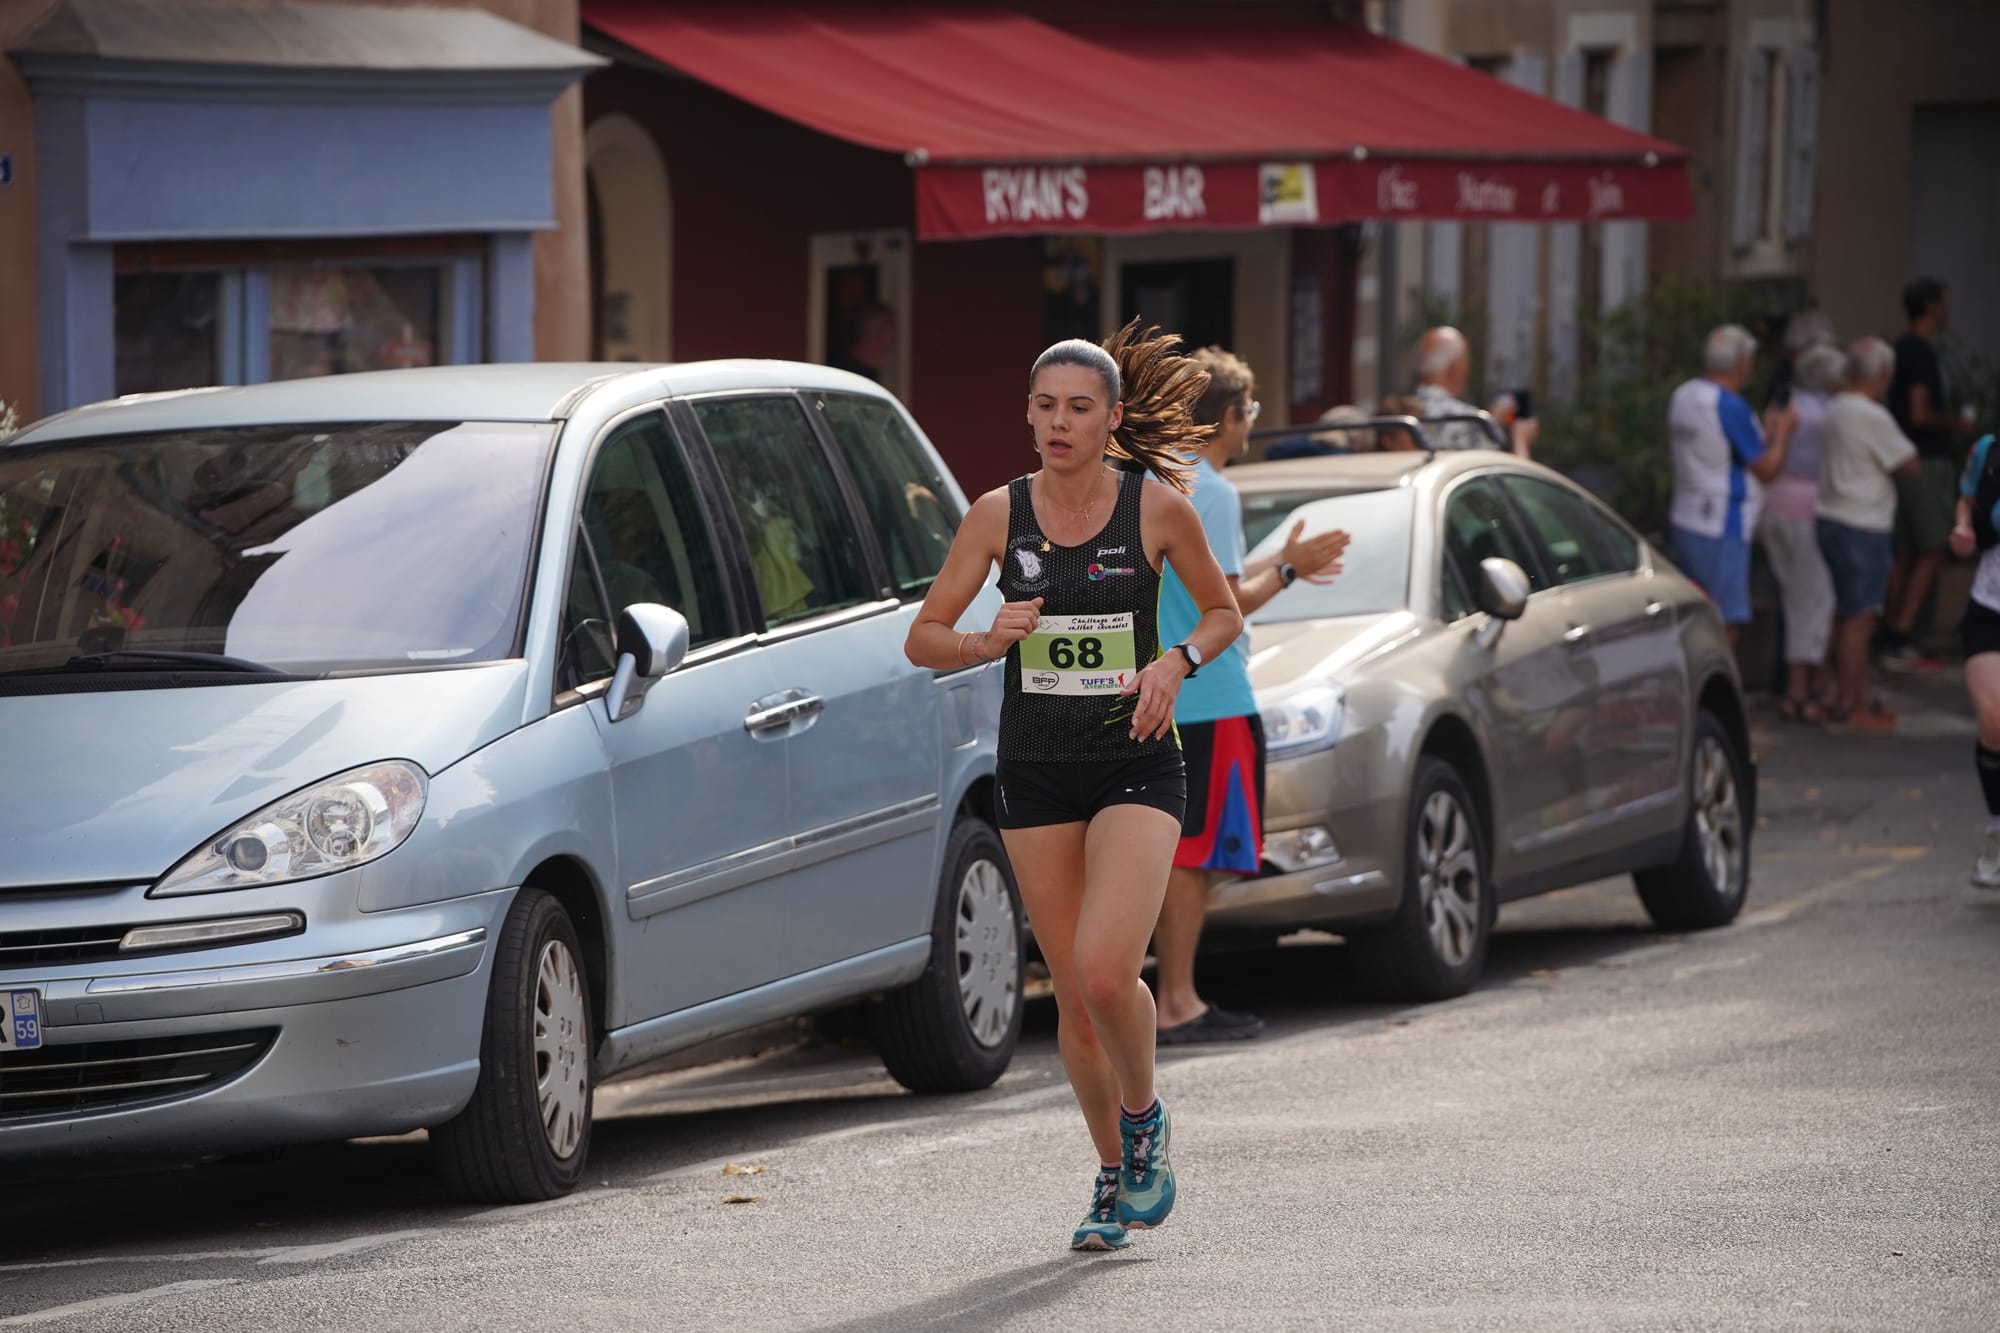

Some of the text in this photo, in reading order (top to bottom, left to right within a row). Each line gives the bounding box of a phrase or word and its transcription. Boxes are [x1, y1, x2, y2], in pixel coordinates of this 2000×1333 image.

[983, 165, 1206, 222] RYAN'S BAR
[1049, 637, 1104, 669] 68
[1080, 677, 1115, 685] TUFF'S
[16, 1019, 38, 1039] 59
